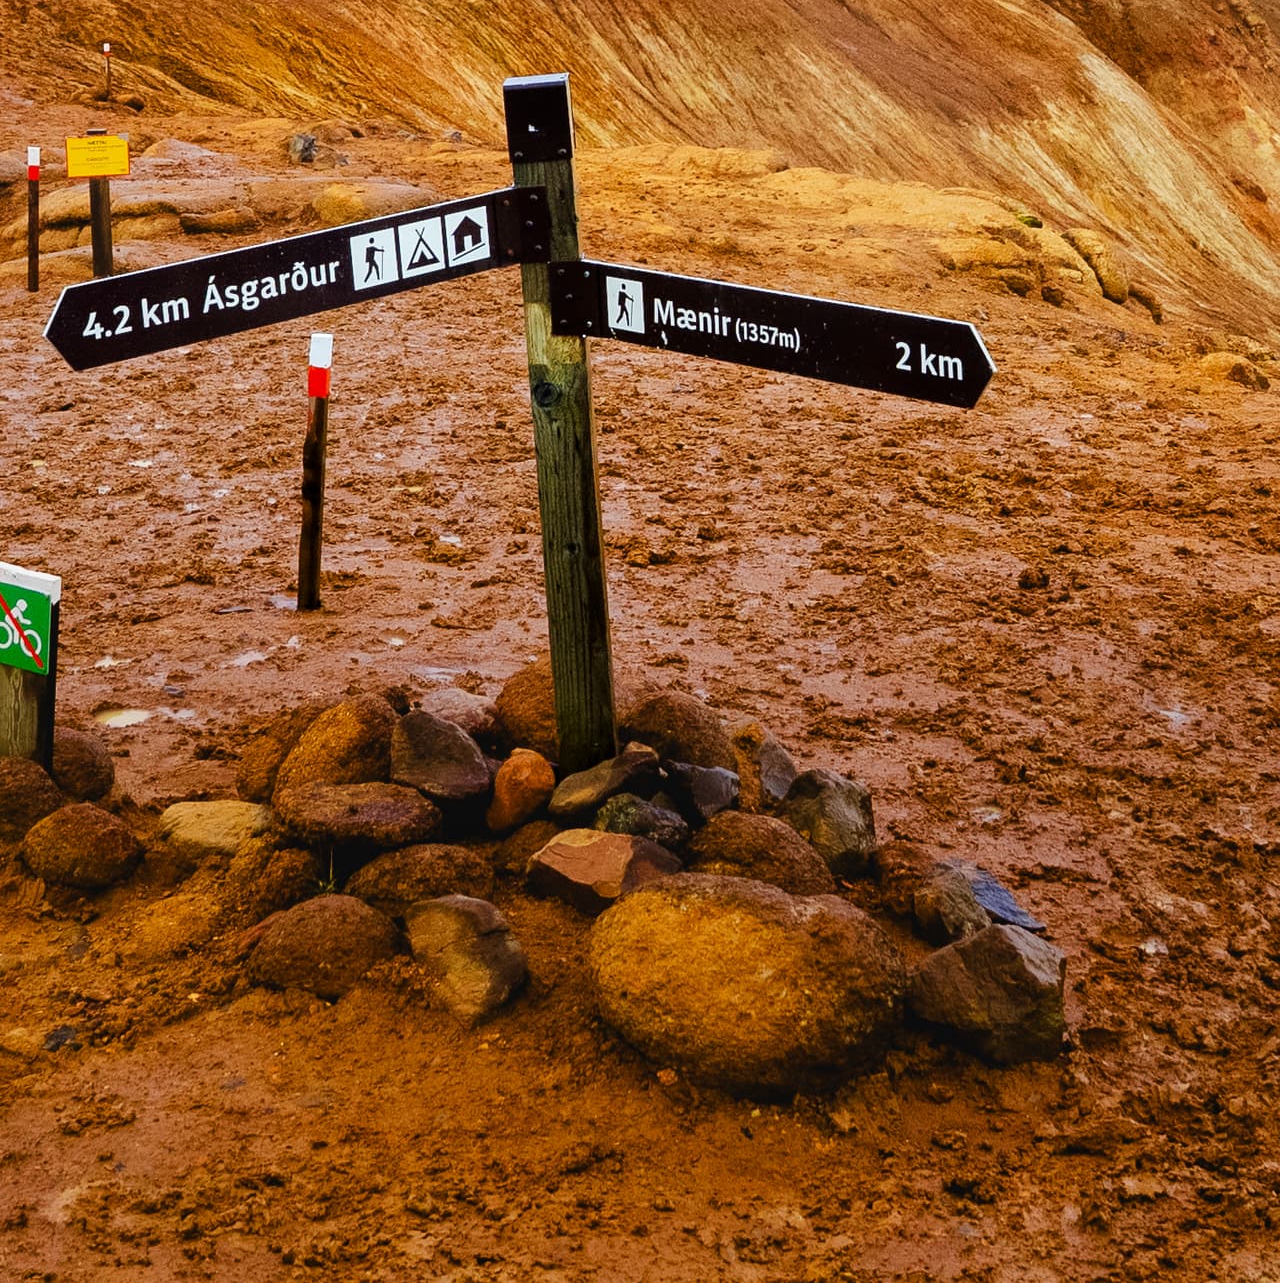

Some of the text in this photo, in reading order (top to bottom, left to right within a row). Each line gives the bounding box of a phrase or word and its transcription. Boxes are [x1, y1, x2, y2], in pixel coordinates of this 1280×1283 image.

[82, 260, 340, 340] 4.2 km Ásgarður
[653, 297, 963, 381] Mænir (1357m) 2 km
